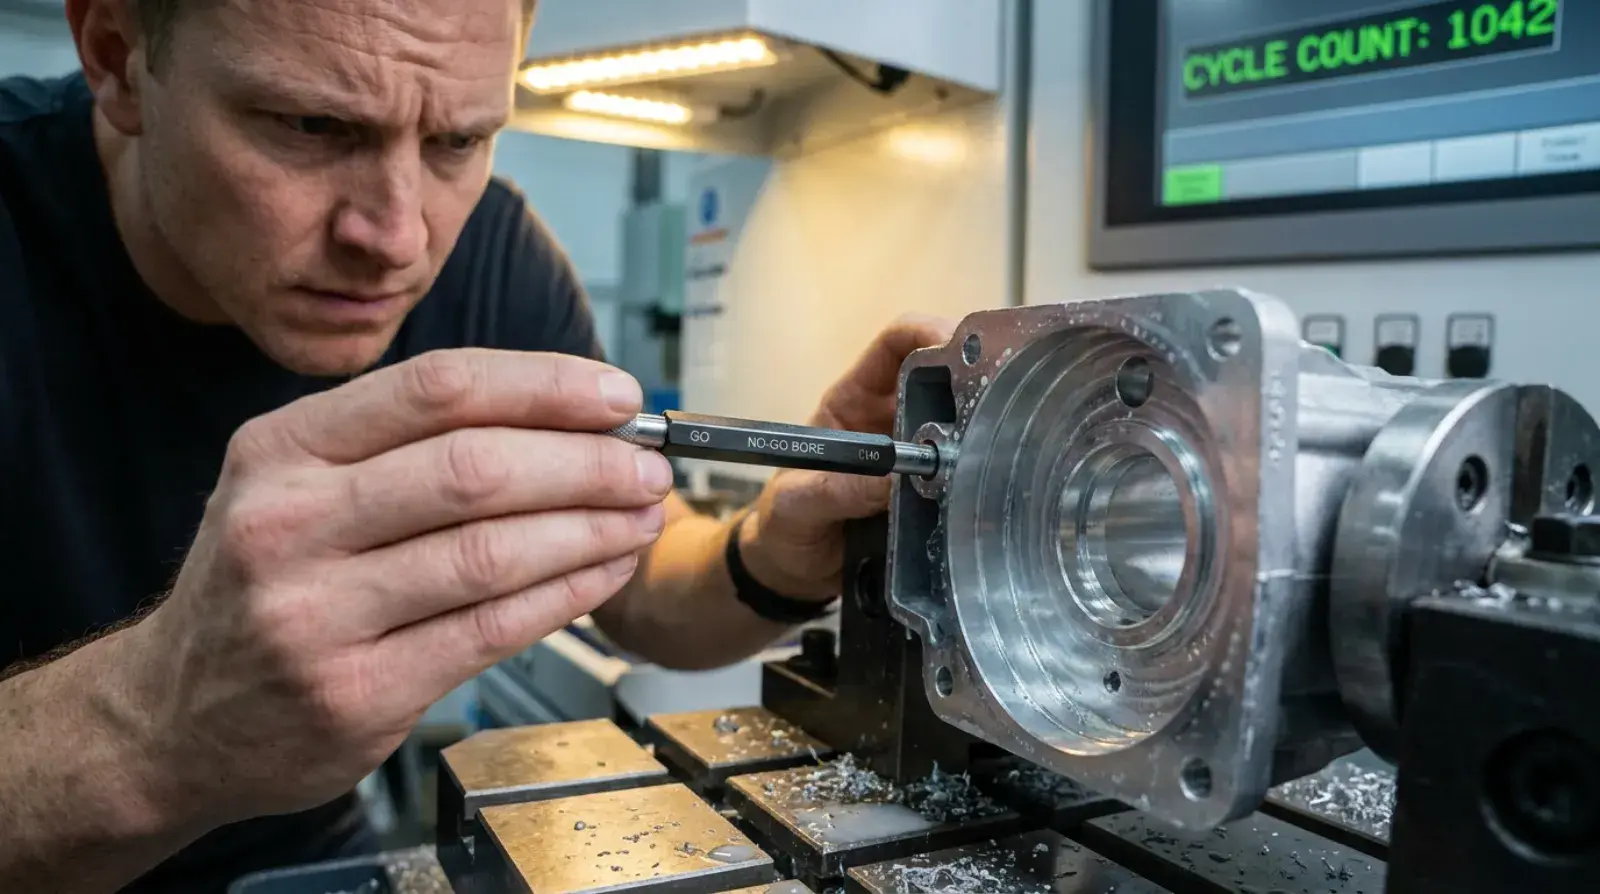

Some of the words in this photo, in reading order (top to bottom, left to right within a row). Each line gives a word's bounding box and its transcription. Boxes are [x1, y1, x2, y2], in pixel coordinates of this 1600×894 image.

[1183, 40, 1288, 90] CYCLE
[1296, 19, 1430, 72] COUNT:
[1447, 0, 1558, 50] 1042
[690, 430, 710, 443] GO
[747, 436, 788, 451] NO-GO
[791, 440, 825, 455] BORE
